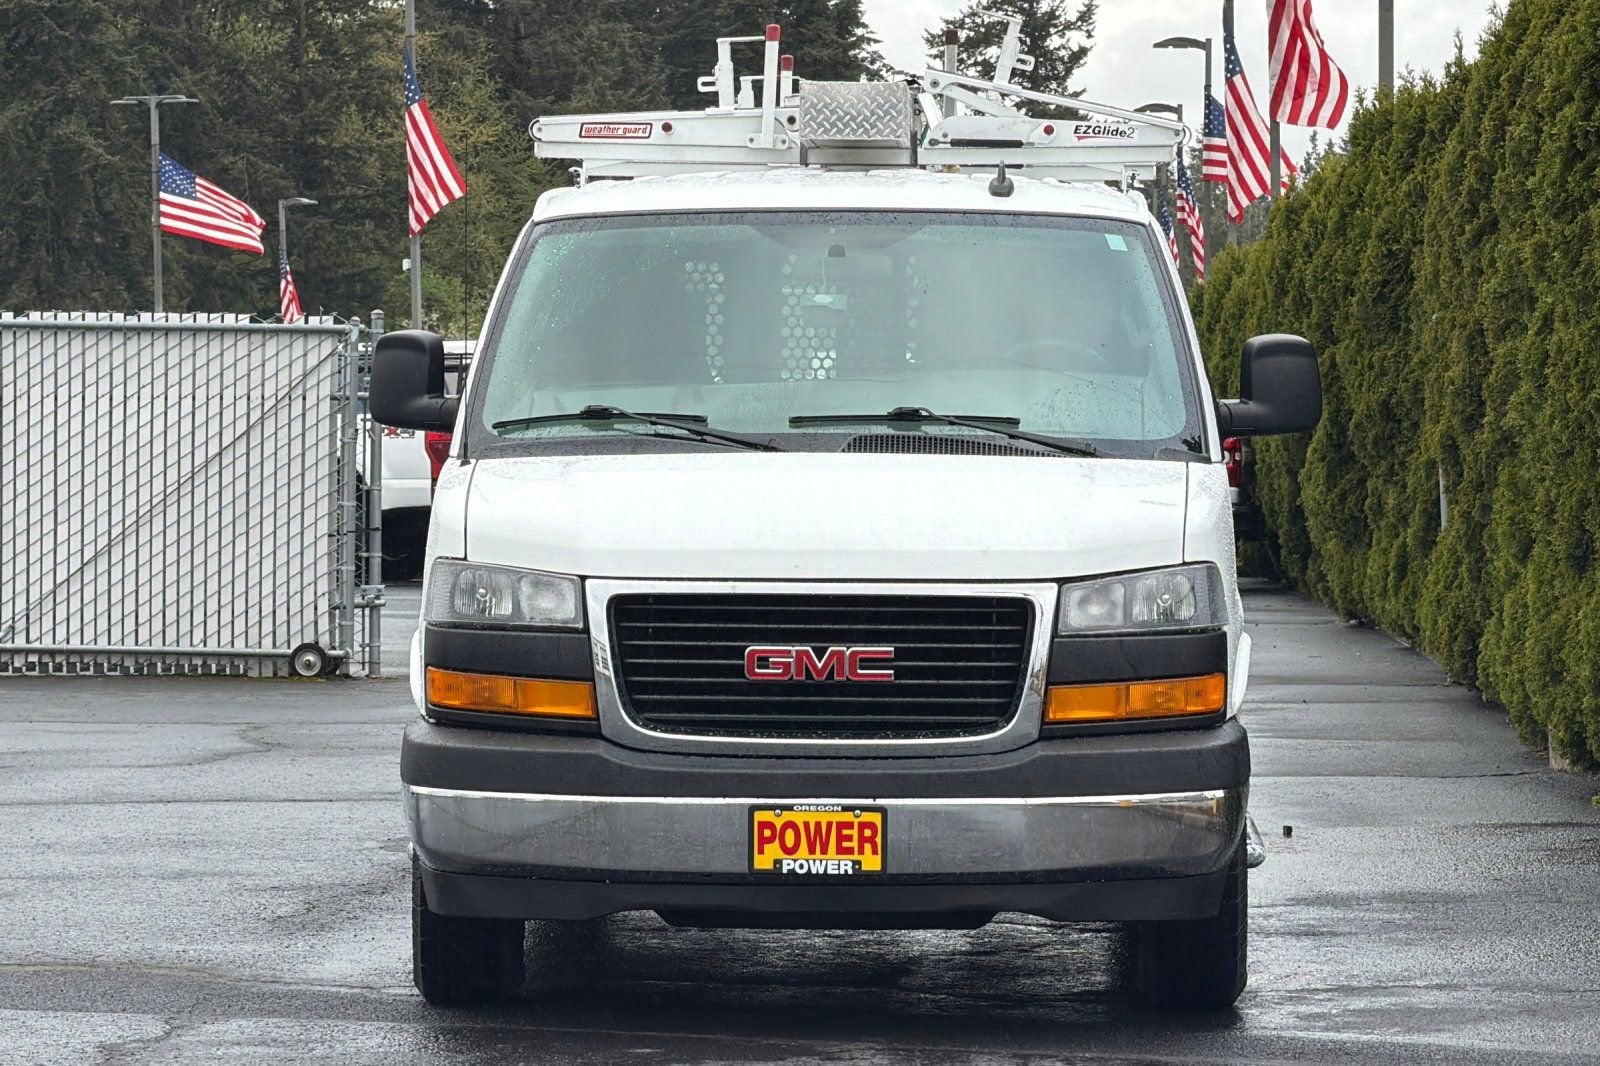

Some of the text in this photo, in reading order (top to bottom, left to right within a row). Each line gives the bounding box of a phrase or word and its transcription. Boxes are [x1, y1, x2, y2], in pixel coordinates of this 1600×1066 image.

[584, 125, 648, 135] weather guard
[1073, 125, 1135, 138] EZGlide2
[745, 646, 894, 681] GMC
[757, 820, 879, 856] POWER
[782, 859, 853, 875] POWER
